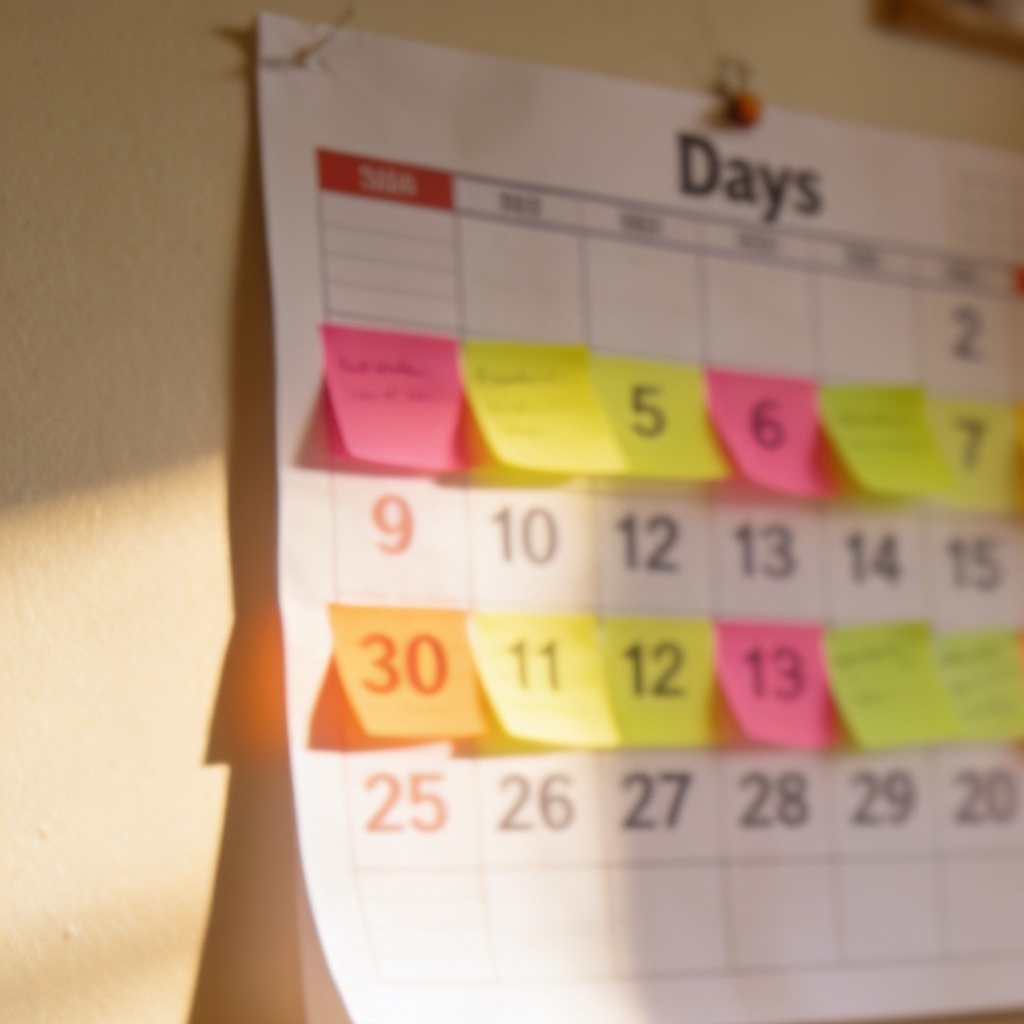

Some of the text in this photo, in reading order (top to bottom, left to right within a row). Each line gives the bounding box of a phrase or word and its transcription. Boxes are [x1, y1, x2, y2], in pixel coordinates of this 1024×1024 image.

[677, 133, 823, 224] Days
[950, 306, 982, 361] 2
[630, 385, 987, 471] 5 6 7
[371, 494, 415, 555] 9
[492, 507, 558, 565] 10
[616, 513, 680, 573] 12
[735, 523, 797, 580] 13
[846, 533, 902, 585] 14
[947, 538, 1004, 592] 15
[358, 633, 449, 695] 30
[507, 640, 559, 691] 11
[624, 642, 686, 697] 12
[746, 648, 806, 700] 13
[363, 772, 448, 832] 25
[498, 773, 575, 832] 26
[621, 771, 692, 831] 27
[739, 771, 810, 829] 28
[850, 769, 915, 826] 29
[955, 769, 1019, 826] 20
